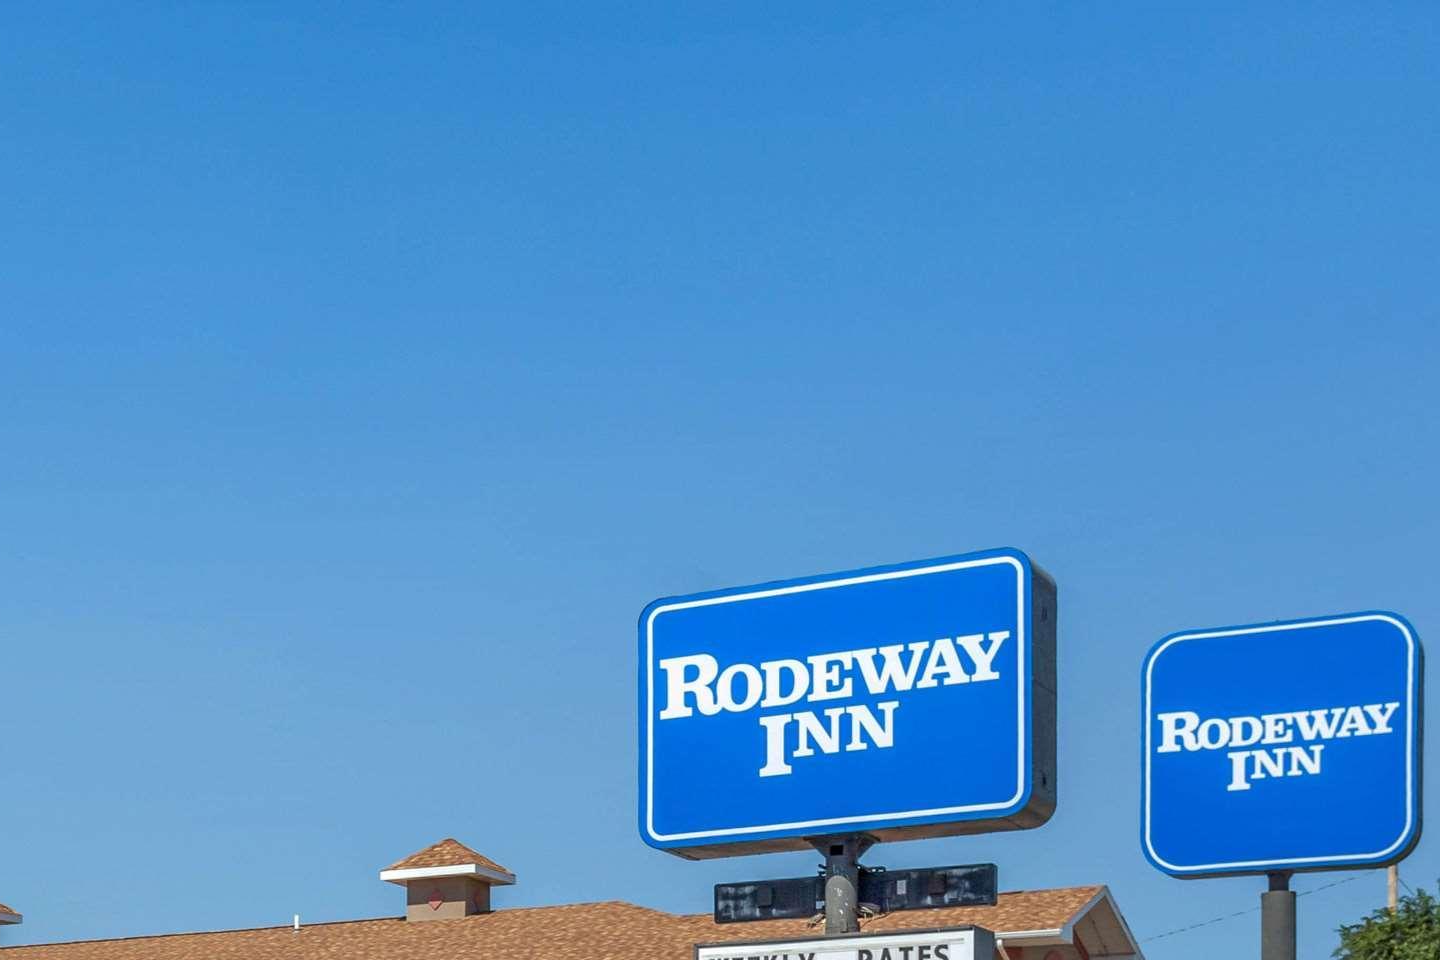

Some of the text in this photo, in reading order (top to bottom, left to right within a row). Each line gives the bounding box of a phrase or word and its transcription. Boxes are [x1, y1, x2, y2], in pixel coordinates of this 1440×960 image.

[659, 630, 1010, 720] RODEWAY
[759, 701, 899, 777] INN
[1157, 702, 1400, 753] RODEWAY
[1227, 745, 1325, 791] INN
